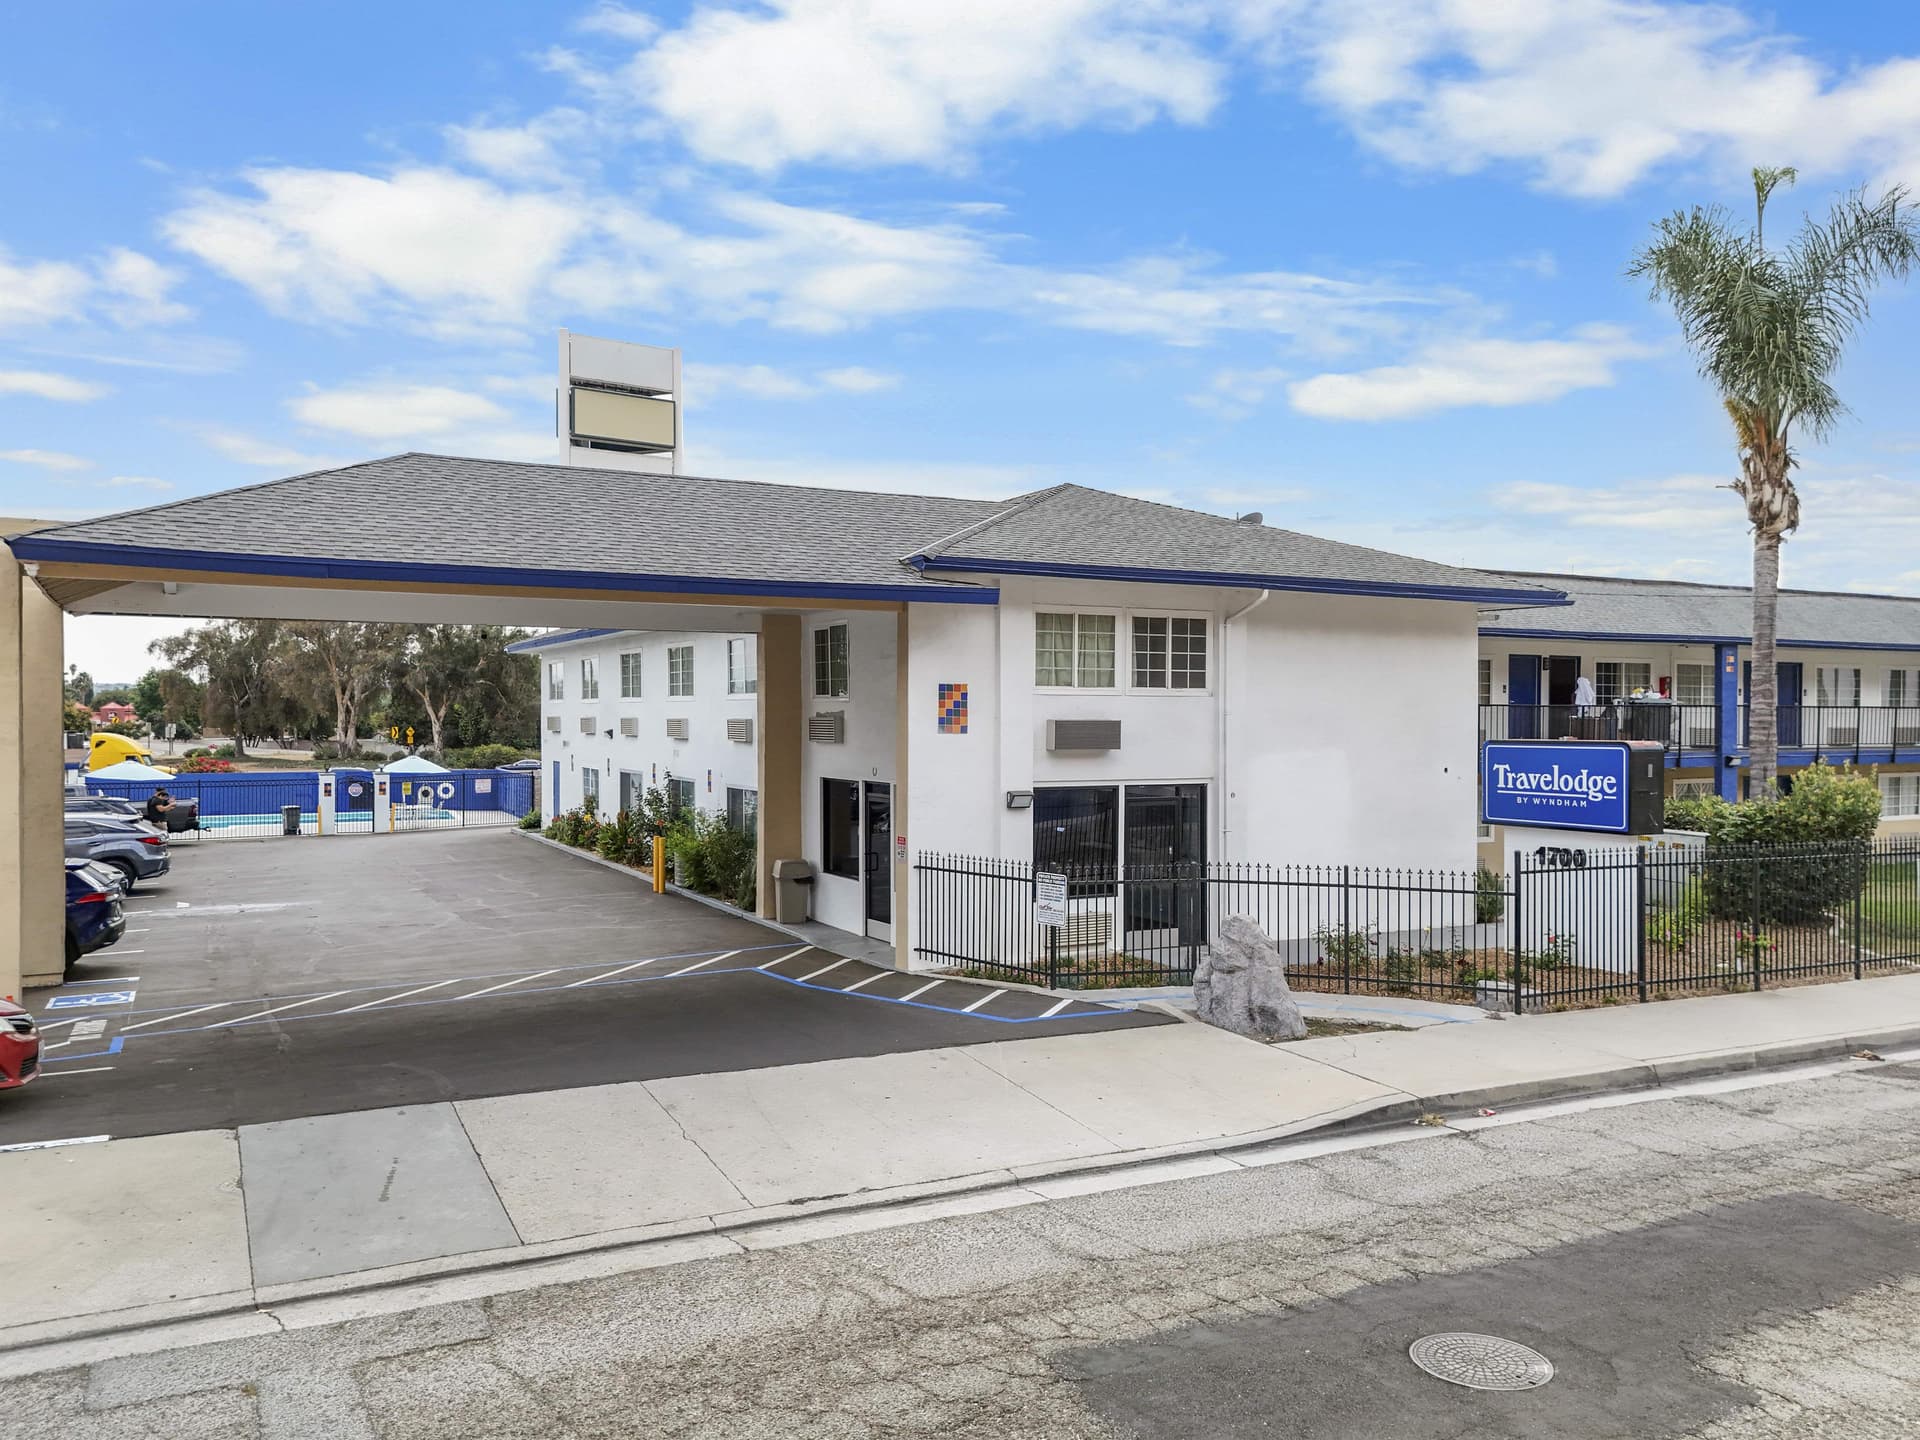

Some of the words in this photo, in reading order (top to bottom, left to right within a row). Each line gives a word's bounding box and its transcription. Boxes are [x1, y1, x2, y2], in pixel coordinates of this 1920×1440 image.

[1493, 763, 1617, 801] Travelodge
[1516, 796, 1529, 804] BY
[1532, 797, 1588, 808] WYNDHAM
[1535, 846, 1588, 868] 1700
